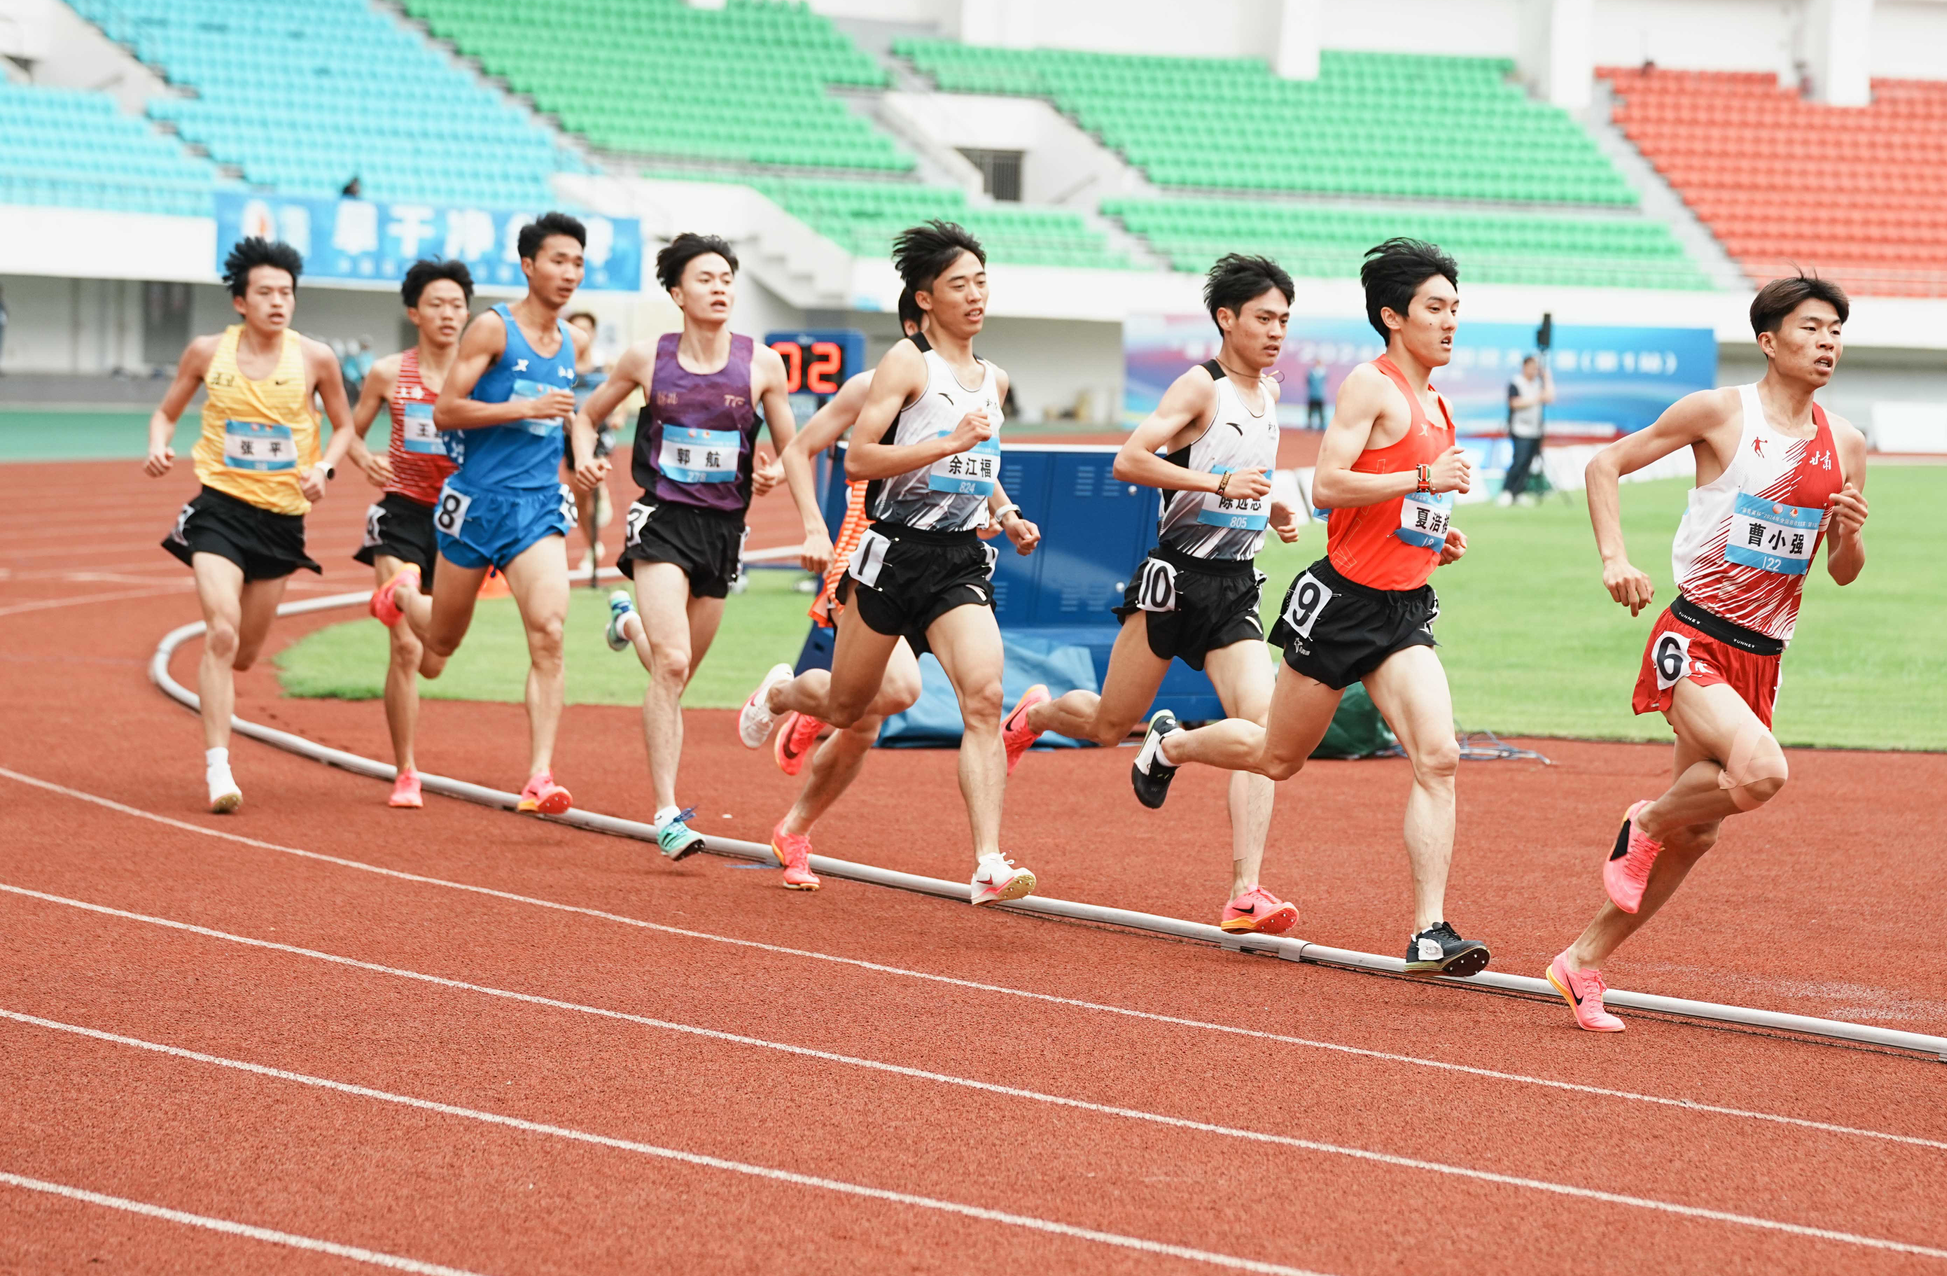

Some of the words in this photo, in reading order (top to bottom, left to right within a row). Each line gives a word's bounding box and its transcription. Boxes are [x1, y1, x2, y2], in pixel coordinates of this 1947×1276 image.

[240, 440, 282, 458] 张平
[676, 447, 721, 469] 郭航
[1808, 449, 1833, 472] 甘肃
[948, 454, 992, 479] 余江福
[958, 481, 977, 494] 824
[438, 494, 461, 529] 8
[1229, 516, 1248, 529] 805
[1747, 522, 1805, 555] 曹小强
[857, 536, 876, 577] 1
[1761, 556, 1782, 572] 122
[1140, 562, 1171, 608] 10
[1292, 581, 1322, 627] 9
[1656, 636, 1684, 682] 6
